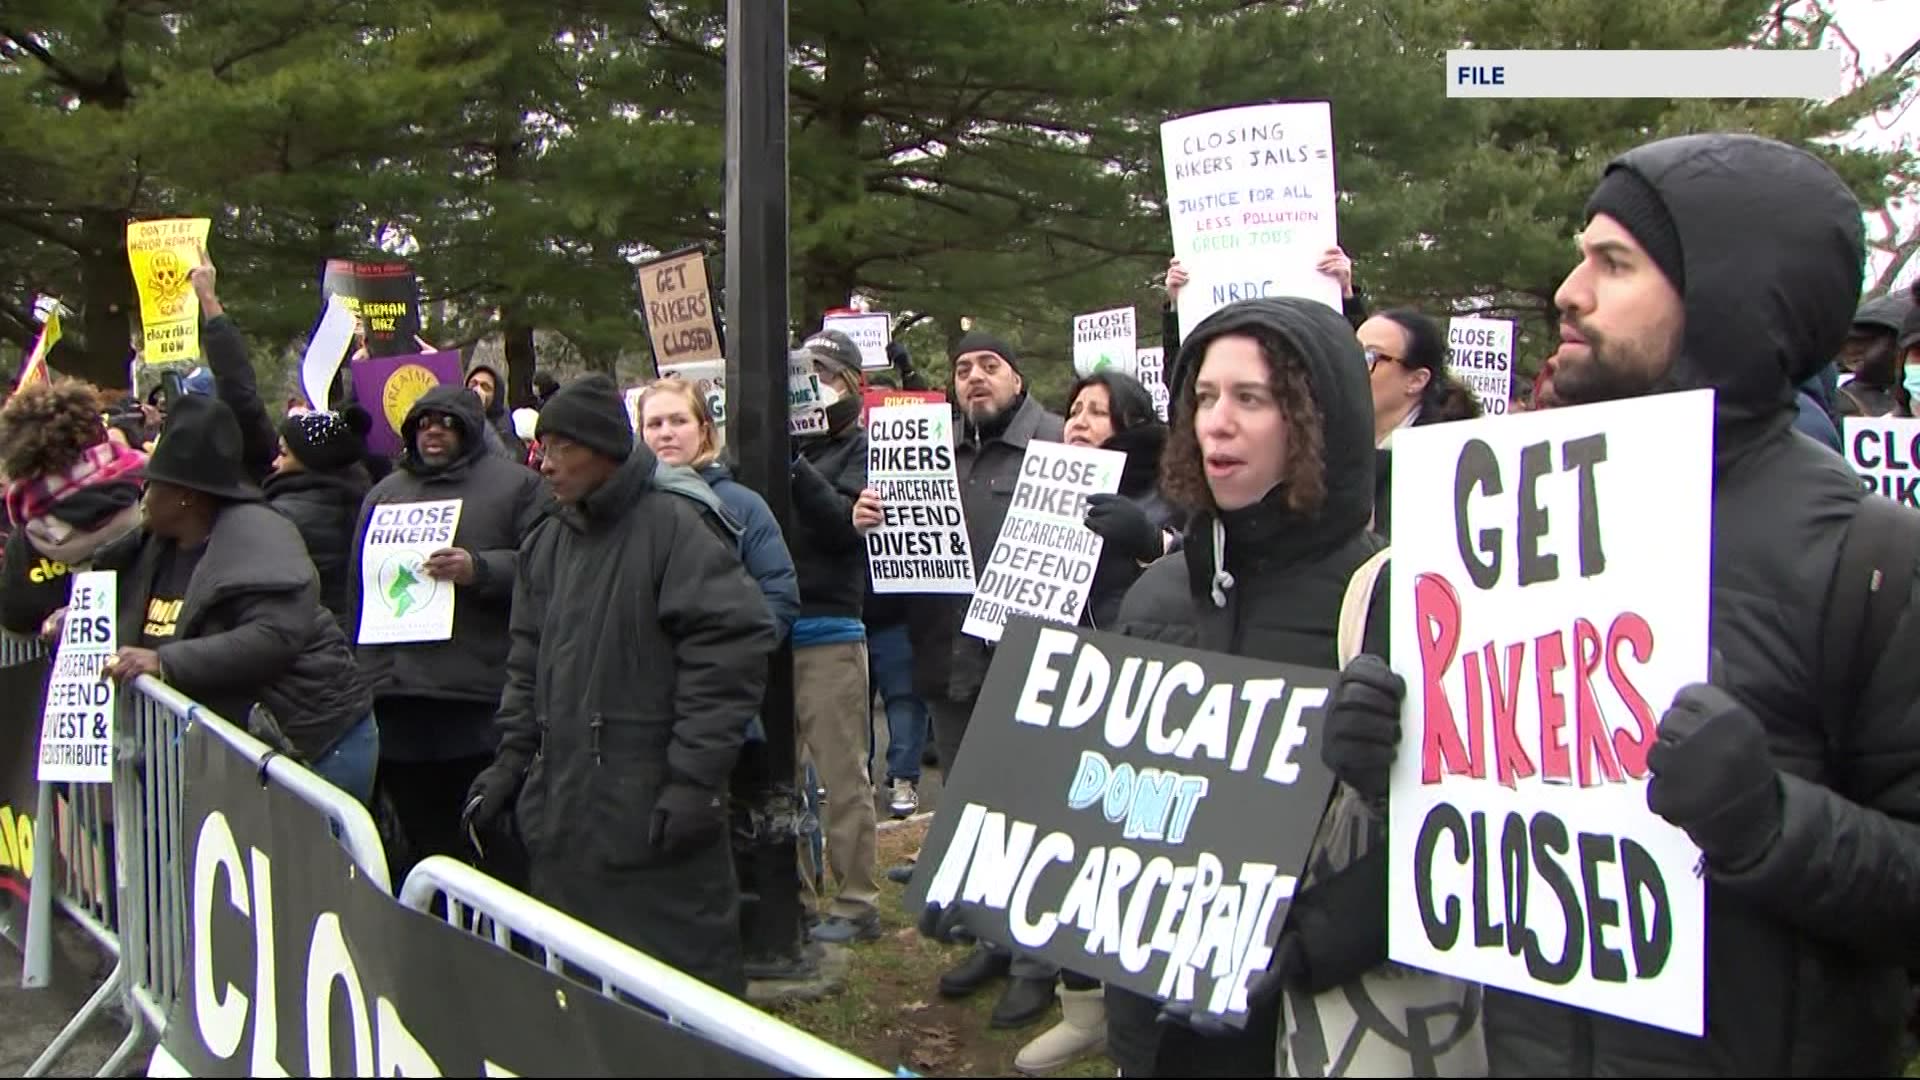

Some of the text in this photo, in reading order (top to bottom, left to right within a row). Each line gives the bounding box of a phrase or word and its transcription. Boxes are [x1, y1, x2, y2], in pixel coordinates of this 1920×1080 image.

[1183, 122, 1285, 156] CLOSING
[1175, 156, 1233, 180] RIKERS
[1249, 145, 1309, 167] JAILS
[1177, 186, 1313, 214] JUSTICE FOR ALL
[1196, 211, 1319, 232] LESS POLLUTION
[1192, 229, 1294, 253] GREEN JOBS
[656, 263, 686, 293] GET
[1212, 280, 1273, 305] NRDC
[649, 292, 707, 327] RIKERS
[1078, 311, 1132, 331] CLOSE
[663, 328, 713, 356] CLOSED
[1078, 325, 1132, 343] RIKERS
[1450, 328, 1496, 347] CLOSE
[1448, 347, 1508, 372] RIKERS
[871, 418, 929, 441] CLOSE
[870, 445, 951, 471] RIKERS
[1025, 454, 1098, 486] CLOSE
[1014, 482, 1091, 518] RIKER
[1454, 431, 1608, 590] GET
[377, 505, 456, 527] CLOSE
[882, 505, 961, 527] EFEND
[370, 525, 450, 545] RIKERS
[868, 531, 967, 556] DIVEST &
[1003, 516, 1102, 556] DECARCERATE
[873, 559, 971, 579] REDISTRIBUTE
[992, 542, 1092, 585] DEFEND
[980, 569, 1080, 617] DIVEST &
[1414, 571, 1659, 790] RIKERS
[1015, 628, 1329, 784] EDUCATE
[93, 712, 108, 739] &
[1068, 750, 1208, 844] DONT
[1414, 802, 1674, 986] CLOSED
[925, 802, 1300, 1015] INCARCERATE
